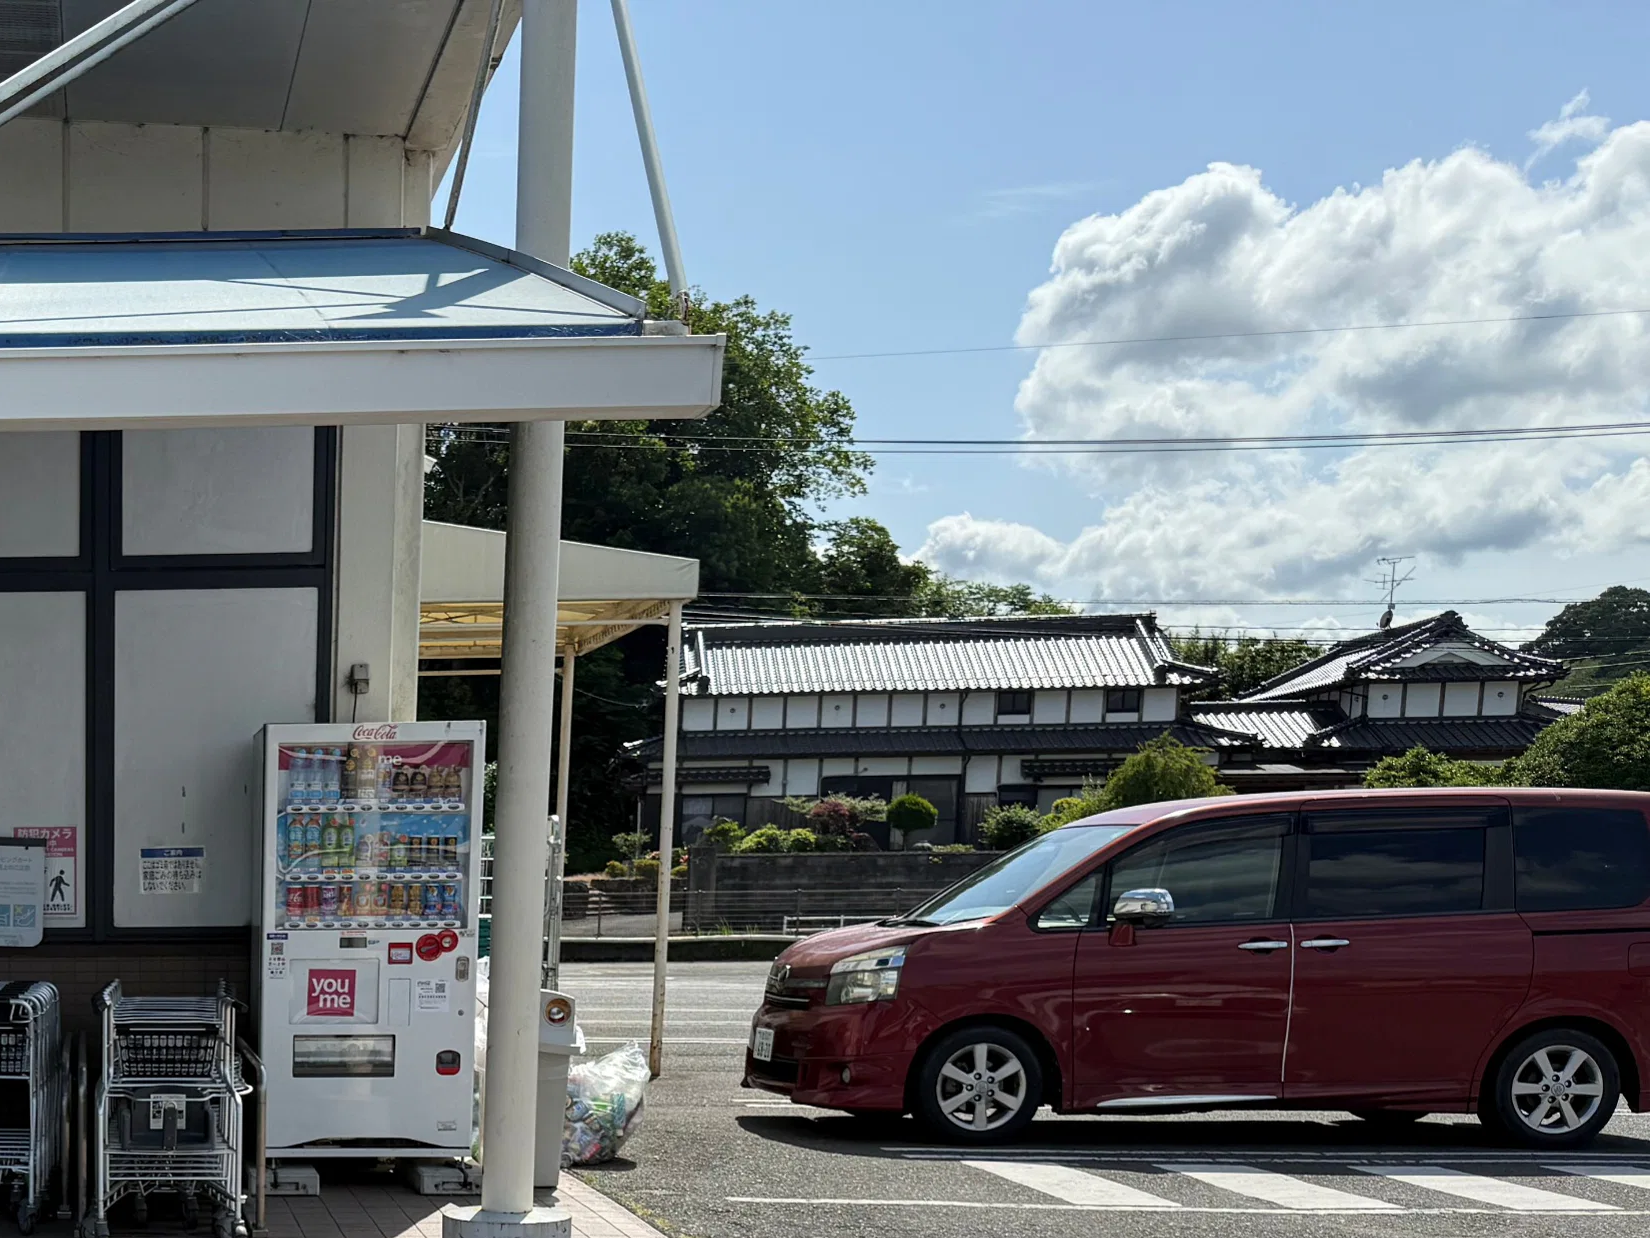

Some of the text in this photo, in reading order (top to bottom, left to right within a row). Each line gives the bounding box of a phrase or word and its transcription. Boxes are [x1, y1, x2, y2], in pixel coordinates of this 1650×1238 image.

[17, 828, 72, 839] 防犯カメラ
[312, 978, 349, 996] you
[319, 994, 351, 1008] me
